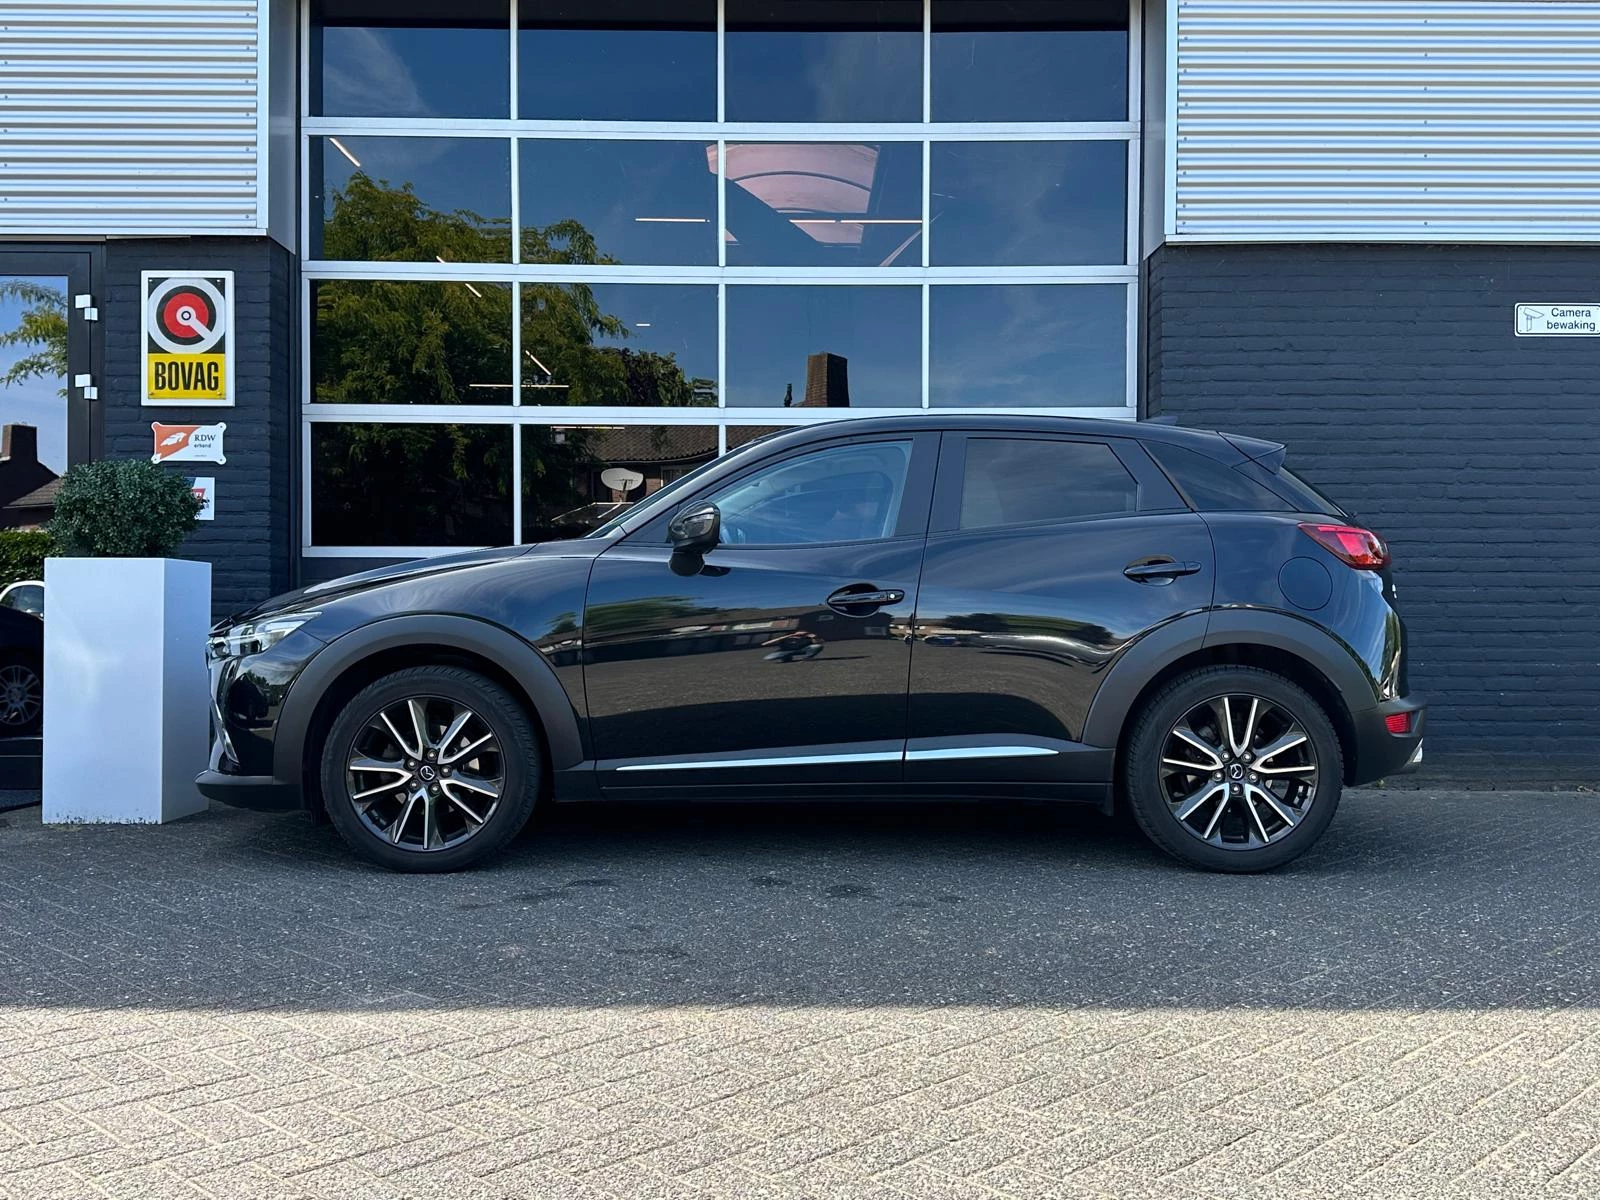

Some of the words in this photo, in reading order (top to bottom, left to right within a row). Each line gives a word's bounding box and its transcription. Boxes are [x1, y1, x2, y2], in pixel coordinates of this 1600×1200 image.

[1551, 307, 1591, 317] Camera
[1546, 320, 1596, 332] bewaking
[154, 361, 219, 391] BOVAG
[194, 434, 216, 442] RDW
